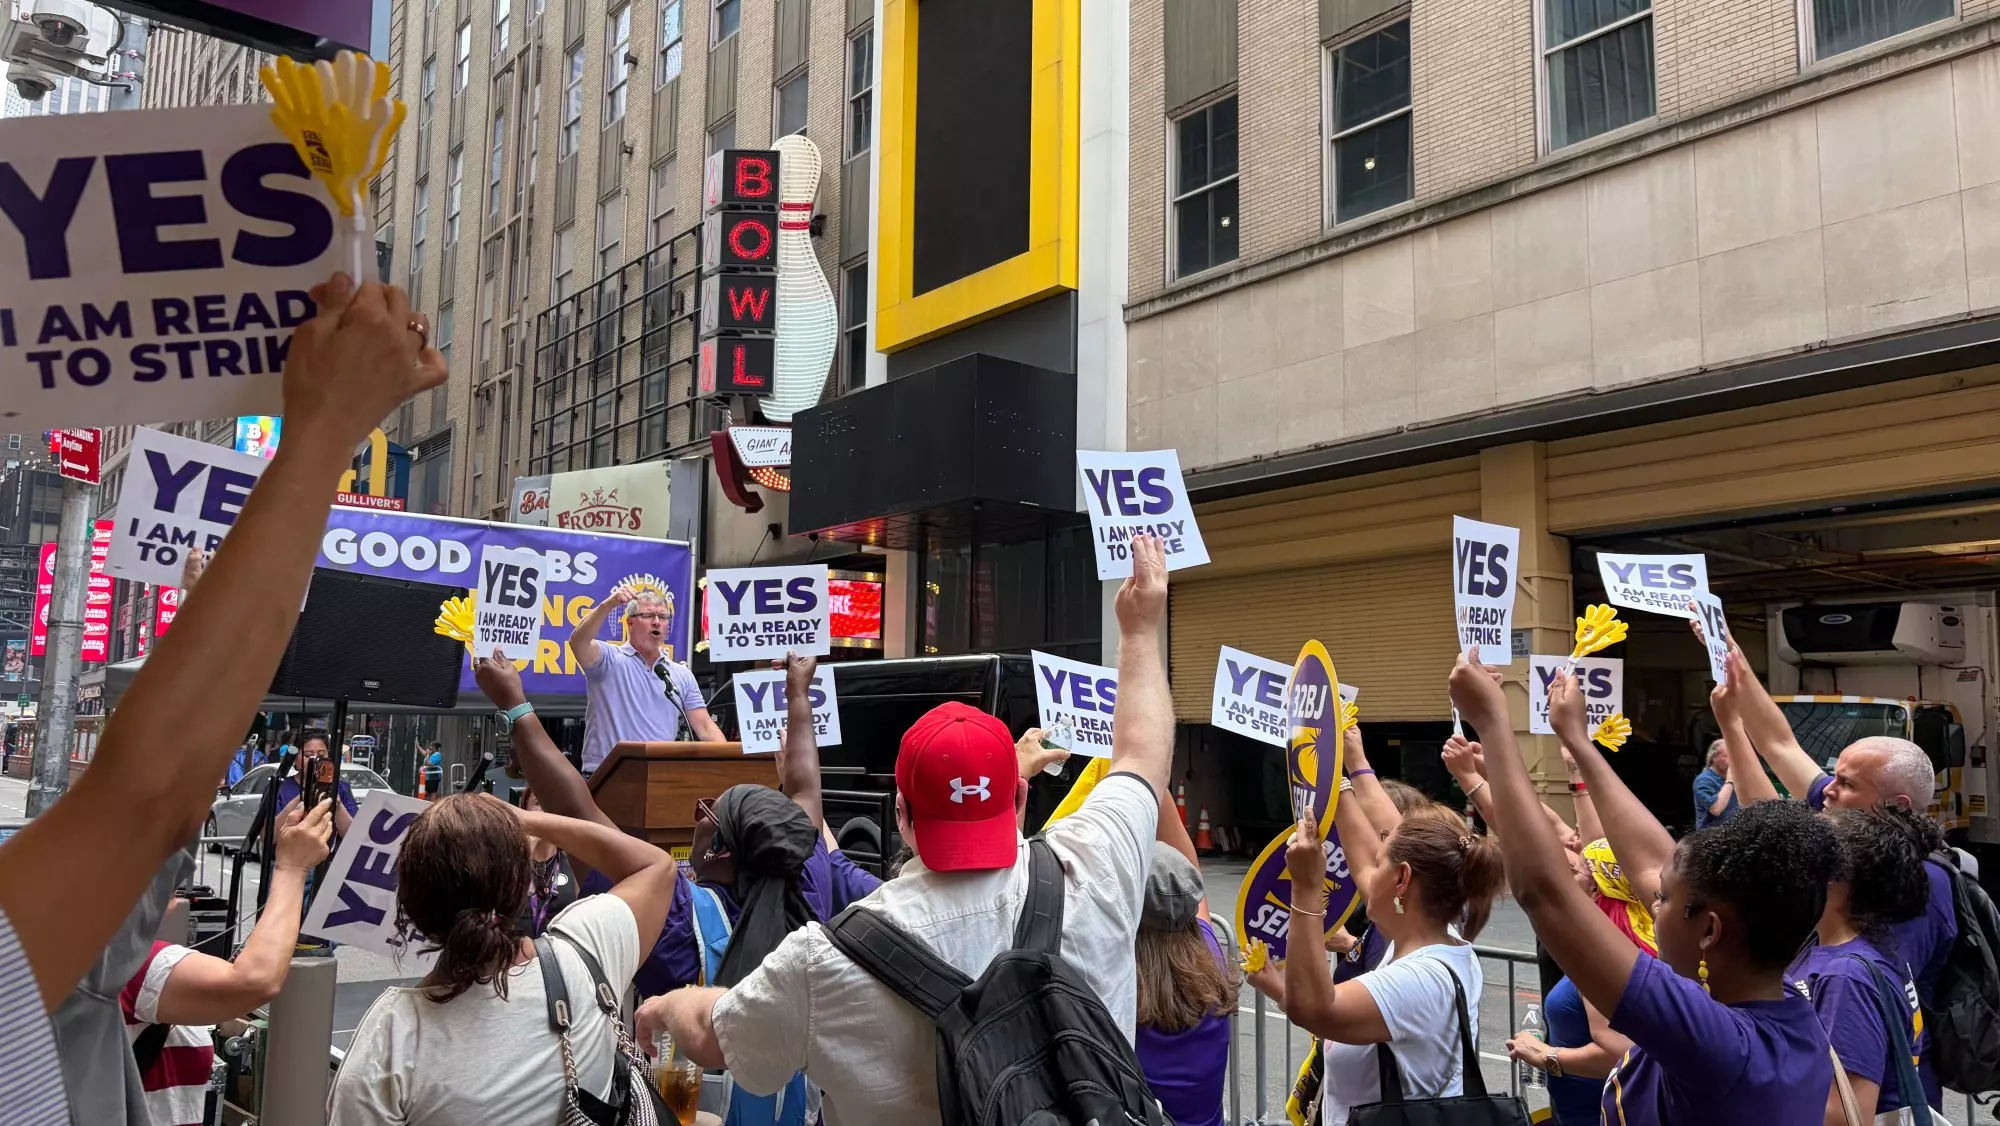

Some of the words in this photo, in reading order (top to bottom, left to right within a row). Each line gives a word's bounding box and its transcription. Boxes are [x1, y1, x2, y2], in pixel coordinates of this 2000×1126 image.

[0, 143, 333, 280] YES
[728, 156, 772, 386] BOWL
[1, 308, 17, 346] I
[38, 301, 133, 344] AM
[152, 289, 318, 336] READ
[26, 347, 111, 389] TO
[130, 336, 293, 382] STRIK
[62, 437, 83, 452] Anytime
[71, 428, 94, 443] STANDING
[747, 438, 779, 451] GIANT
[144, 448, 258, 526] YE
[1084, 467, 1174, 516] YES
[556, 507, 643, 530] FROSTYS
[129, 518, 139, 536] I
[146, 523, 197, 549] AM
[1100, 526, 1106, 543] I
[1109, 526, 1129, 542] AM
[137, 541, 178, 566] TO
[322, 528, 472, 573] GOOD
[1107, 544, 1127, 560] TO
[1456, 537, 1509, 598] YES
[1604, 561, 1697, 590] YES
[484, 559, 539, 609] YES
[714, 577, 818, 615] YES
[1623, 588, 1645, 597] AM
[1650, 592, 1693, 602] READ
[1620, 594, 1641, 603] TO
[1645, 599, 1688, 611] STRIK
[478, 612, 482, 626] I
[482, 612, 497, 627] AM
[498, 613, 536, 631] READY
[718, 623, 723, 635] I
[729, 622, 757, 634] AM
[763, 619, 821, 633] READY
[1469, 607, 1507, 625] READY
[1697, 600, 1727, 641] YE
[480, 628, 491, 642] TO
[492, 628, 530, 645] STRIKE
[725, 636, 749, 647] TO
[755, 632, 815, 646] STRIKE
[1466, 627, 1501, 645] STRIKE
[1039, 664, 1117, 714] YES
[1226, 659, 1289, 710] YE
[1221, 697, 1226, 707] I
[1230, 701, 1254, 717] AM
[1259, 710, 1287, 729] REA
[1292, 684, 1328, 720] 32BJ
[1536, 702, 1539, 711] I
[747, 720, 751, 730] I
[755, 719, 777, 730] AM
[1046, 709, 1051, 721] I
[1080, 717, 1113, 732] REA
[1226, 710, 1246, 725] TO
[1251, 719, 1287, 739] STRI
[753, 730, 772, 741] TO
[1076, 730, 1113, 745] STRI
[1248, 904, 1291, 938] SEI
